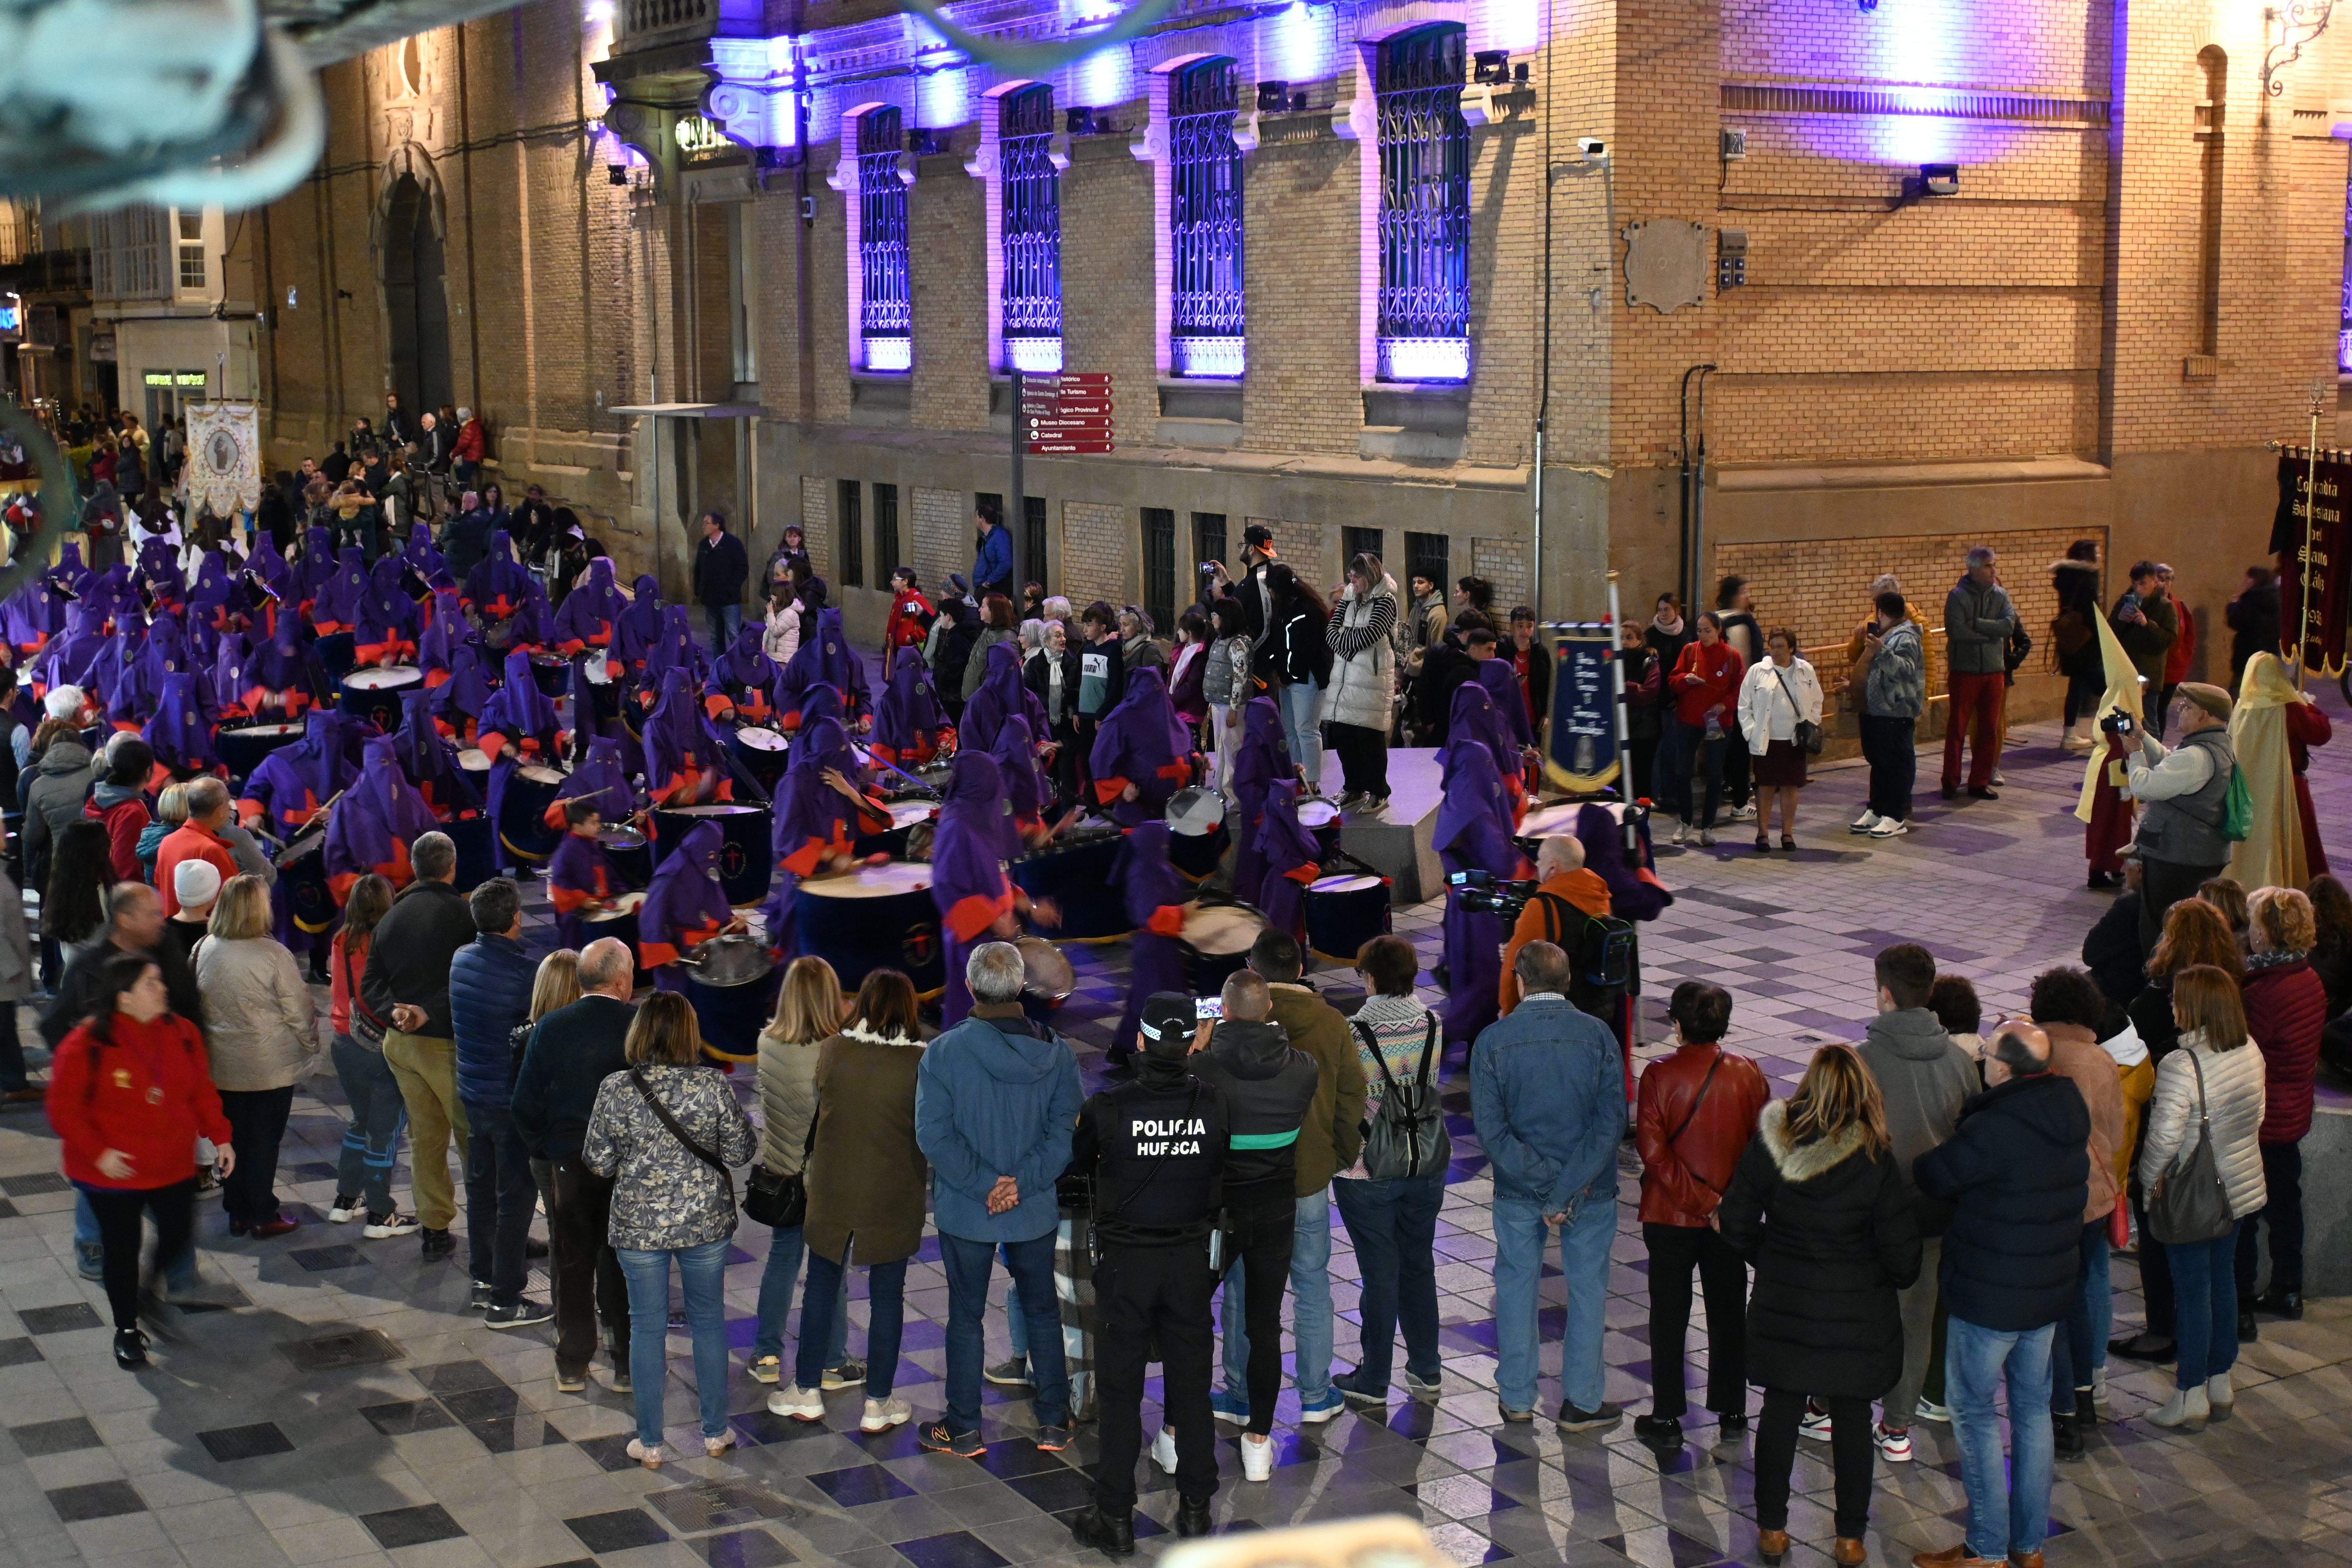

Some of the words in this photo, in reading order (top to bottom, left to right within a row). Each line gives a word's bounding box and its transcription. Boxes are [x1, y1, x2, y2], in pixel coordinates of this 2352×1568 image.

[2297, 475, 2338, 497] Coradía
[1084, 664, 1097, 673] PUMA
[1132, 1119, 1206, 1136] POLICIA
[1137, 1141, 1200, 1155] HUESCA
